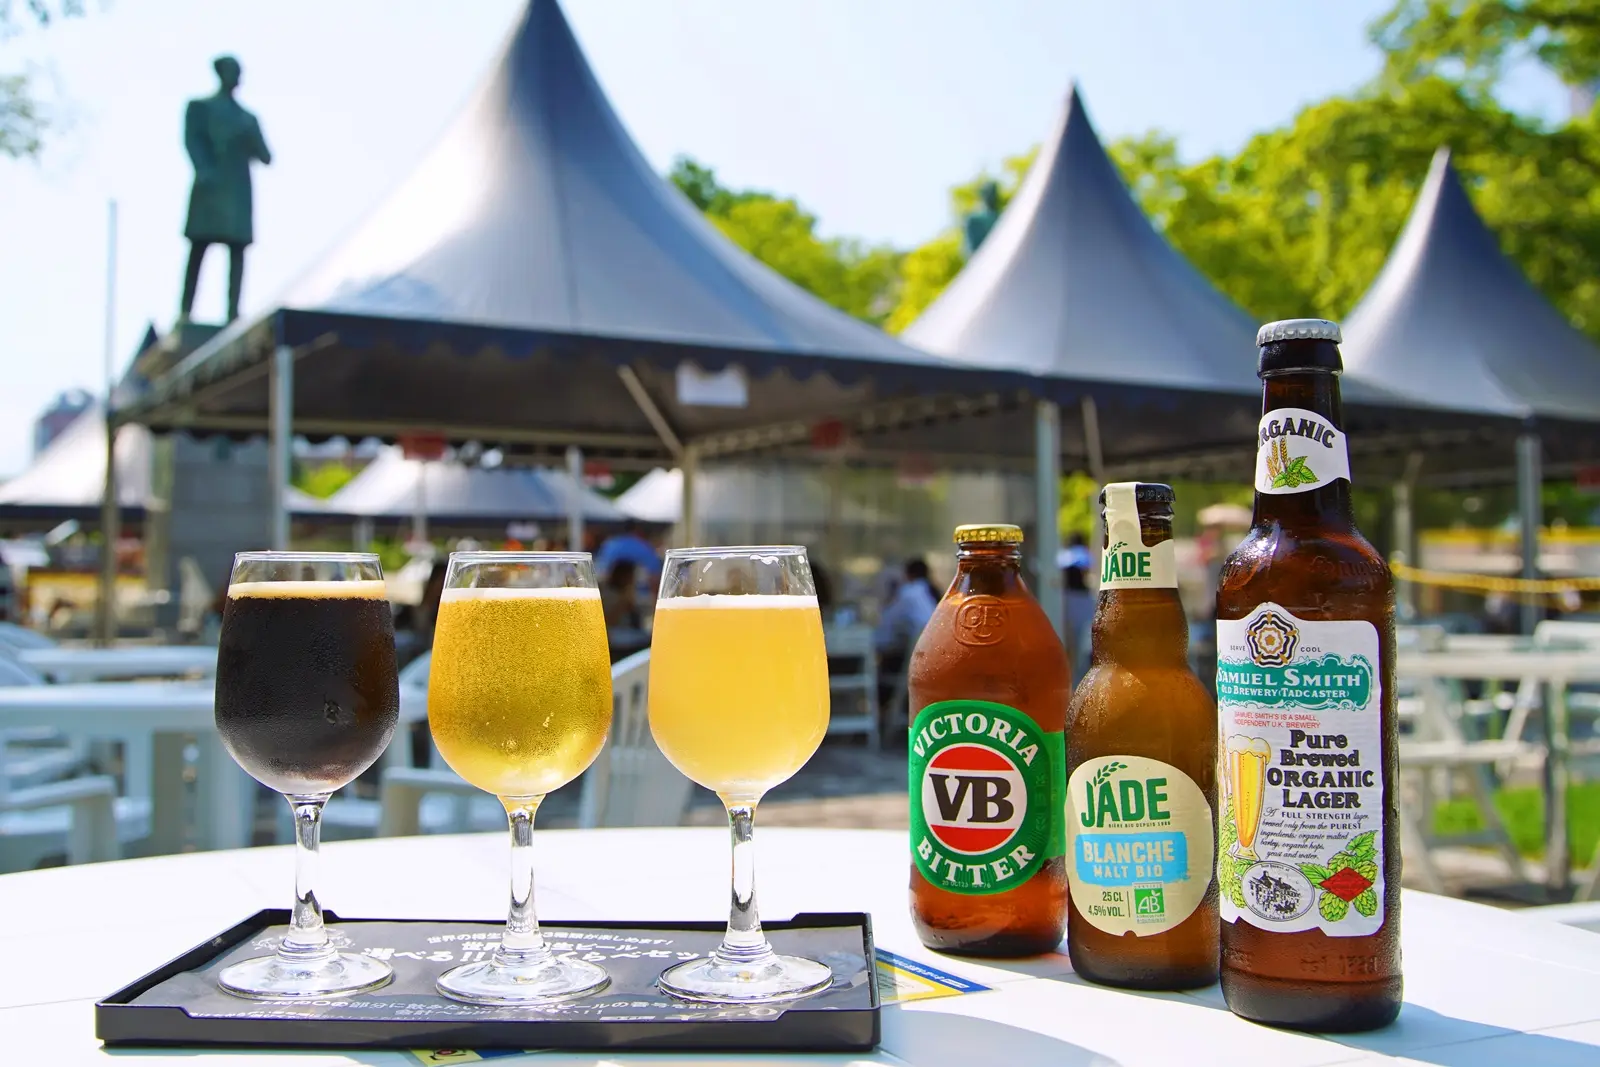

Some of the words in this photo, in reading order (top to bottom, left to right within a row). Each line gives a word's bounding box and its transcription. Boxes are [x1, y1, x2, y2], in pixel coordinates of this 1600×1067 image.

[1259, 418, 1335, 449] RGANIC
[1102, 552, 1151, 582] JADE
[1218, 667, 1277, 686] SAMUEL
[1233, 684, 1278, 697] BREWERY
[1255, 712, 1279, 720] SMITH'S
[913, 713, 1039, 767] VICTORIA
[1289, 729, 1348, 749] Pure
[1280, 749, 1360, 767] Brewed
[1267, 767, 1374, 788] ORGANIC
[929, 773, 1015, 823] VB
[1081, 778, 1170, 827] JADE
[1282, 789, 1361, 809] LAGER
[1262, 819, 1284, 828] brewed
[1284, 821, 1298, 831] only
[1297, 821, 1316, 831] from
[1298, 833, 1325, 842] organic
[1326, 831, 1349, 840] malted
[1083, 840, 1175, 863] BLANCHE
[1281, 842, 1308, 852] organic
[1283, 850, 1299, 858] and
[917, 836, 1036, 885] BITTER
[1094, 864, 1128, 878] MALT
[1136, 864, 1163, 878] BIO
[1102, 891, 1112, 901] 25
[1113, 891, 1124, 902] CL
[1137, 896, 1160, 913] AB
[1107, 907, 1125, 917] VOL.
